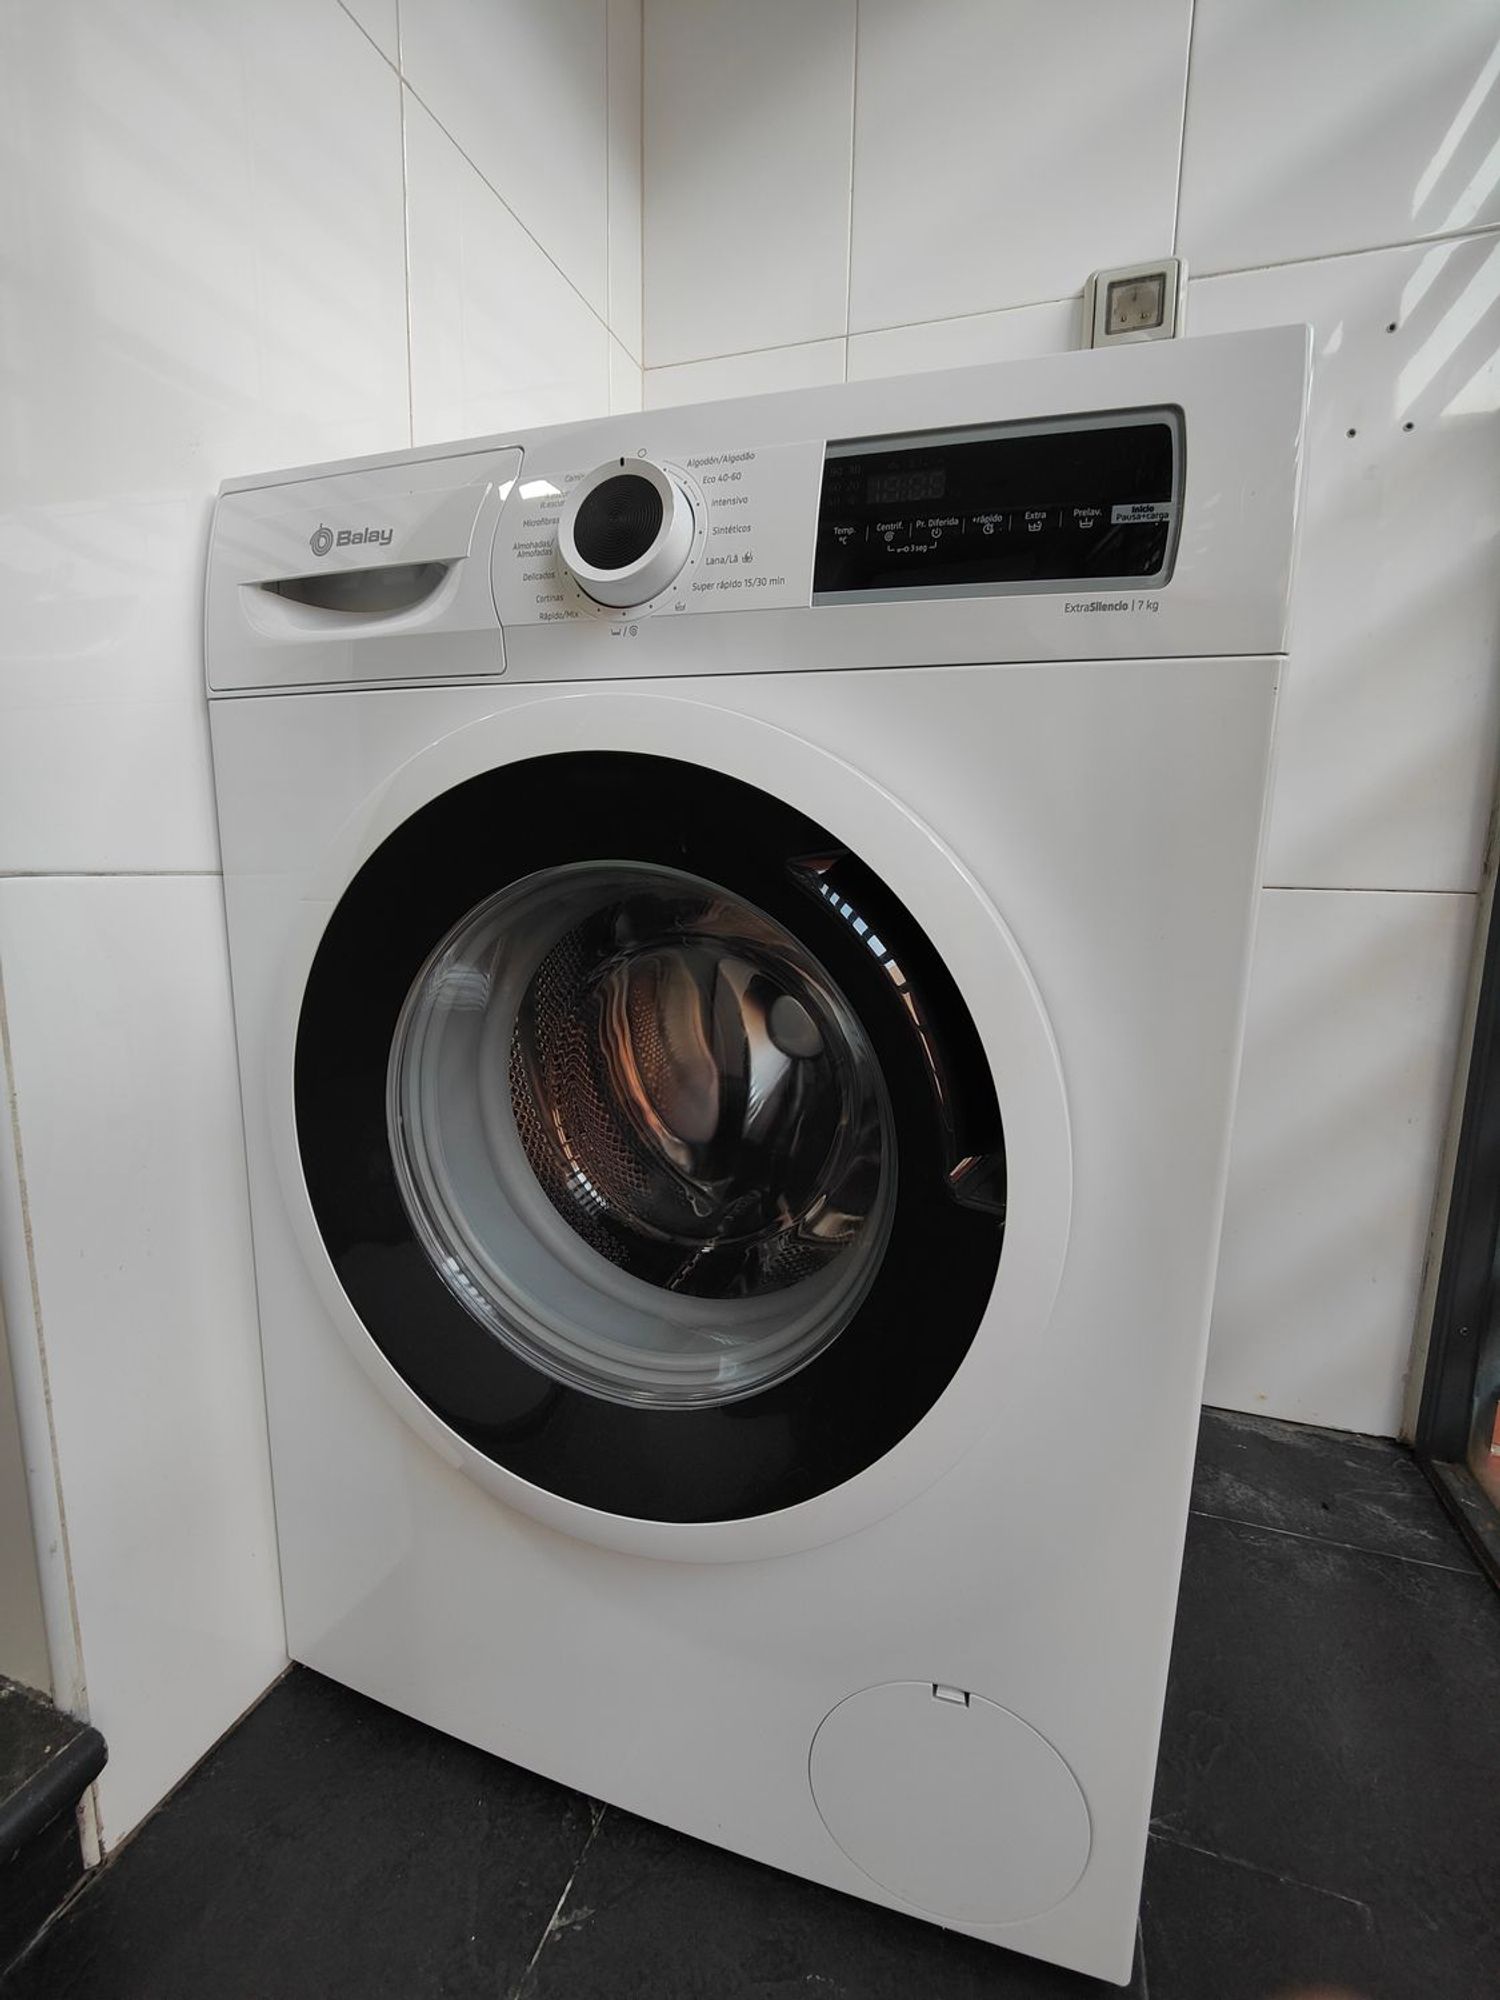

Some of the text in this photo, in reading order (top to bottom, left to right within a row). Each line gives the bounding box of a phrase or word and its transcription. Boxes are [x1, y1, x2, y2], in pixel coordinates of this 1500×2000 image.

[702, 472, 742, 484] Eco 40-60
[1073, 508, 1102, 517] Prelav.
[1131, 505, 1155, 513] Inicio
[1025, 511, 1047, 519] Extra
[1115, 511, 1169, 521] Pausa+carga
[522, 517, 560, 528] Microfibras
[928, 517, 959, 527] Diferida
[712, 524, 752, 536] Sintéticos
[834, 527, 856, 536] Temp.
[336, 527, 393, 547] Balay
[705, 552, 739, 566] Lana/Lã
[522, 571, 556, 582] Delicados
[692, 576, 785, 592] Super rápido 15/30 min
[1138, 601, 1145, 611] 7
[1146, 600, 1159, 612] kg
